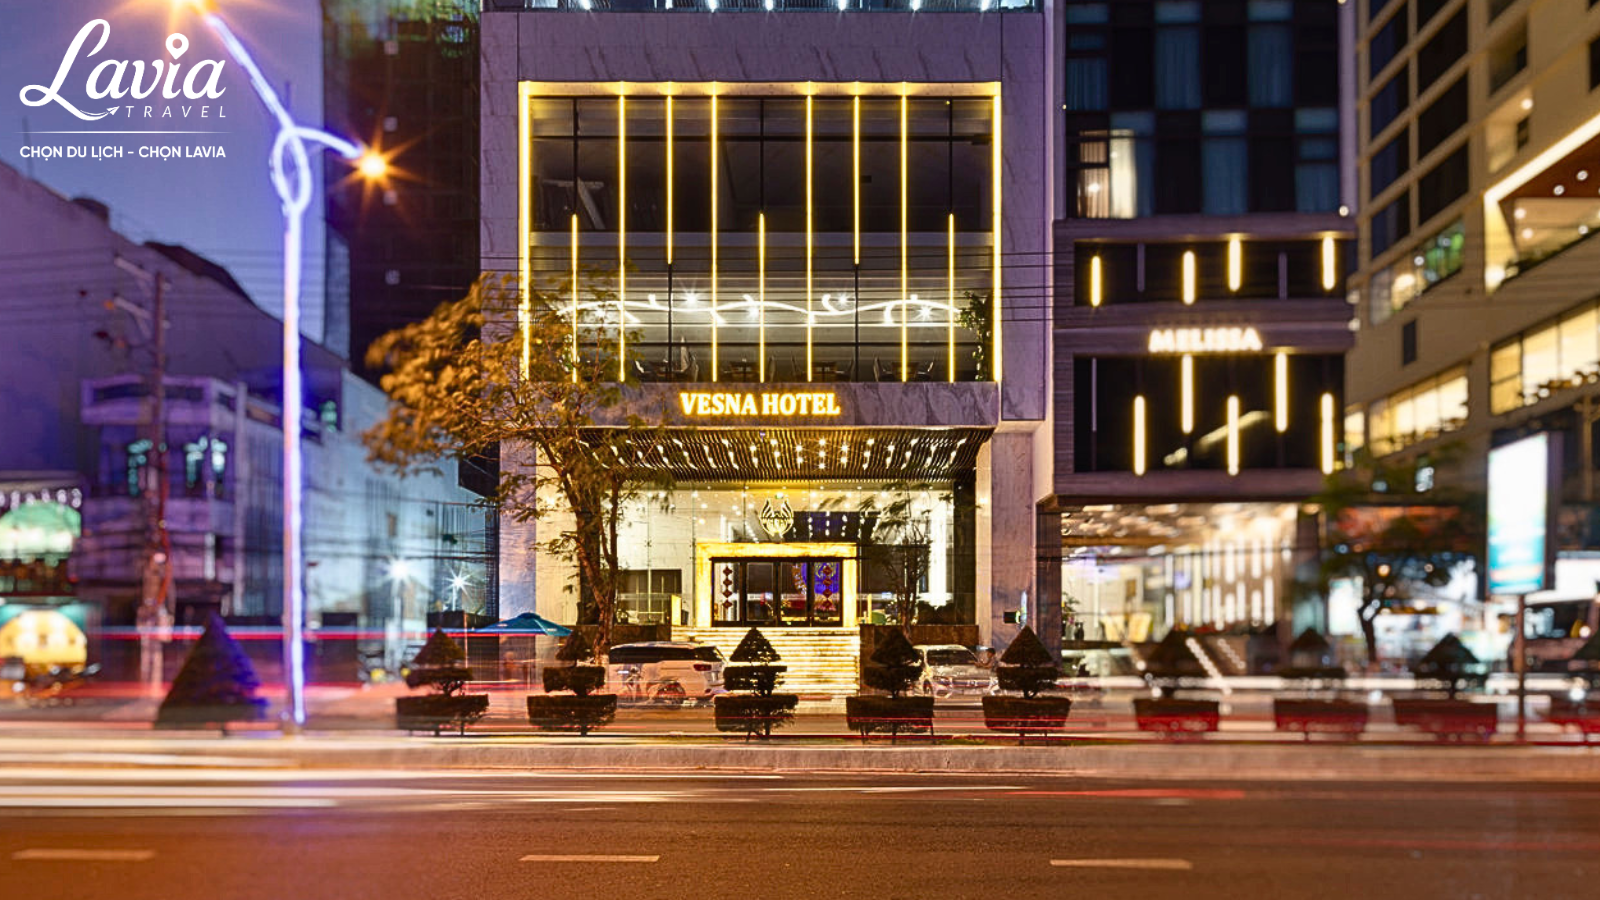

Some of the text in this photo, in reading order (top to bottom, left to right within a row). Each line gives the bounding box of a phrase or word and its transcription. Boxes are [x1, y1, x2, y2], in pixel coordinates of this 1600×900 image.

[1148, 327, 1263, 353] MELISSA
[680, 392, 841, 415] VESNA HOTEL
